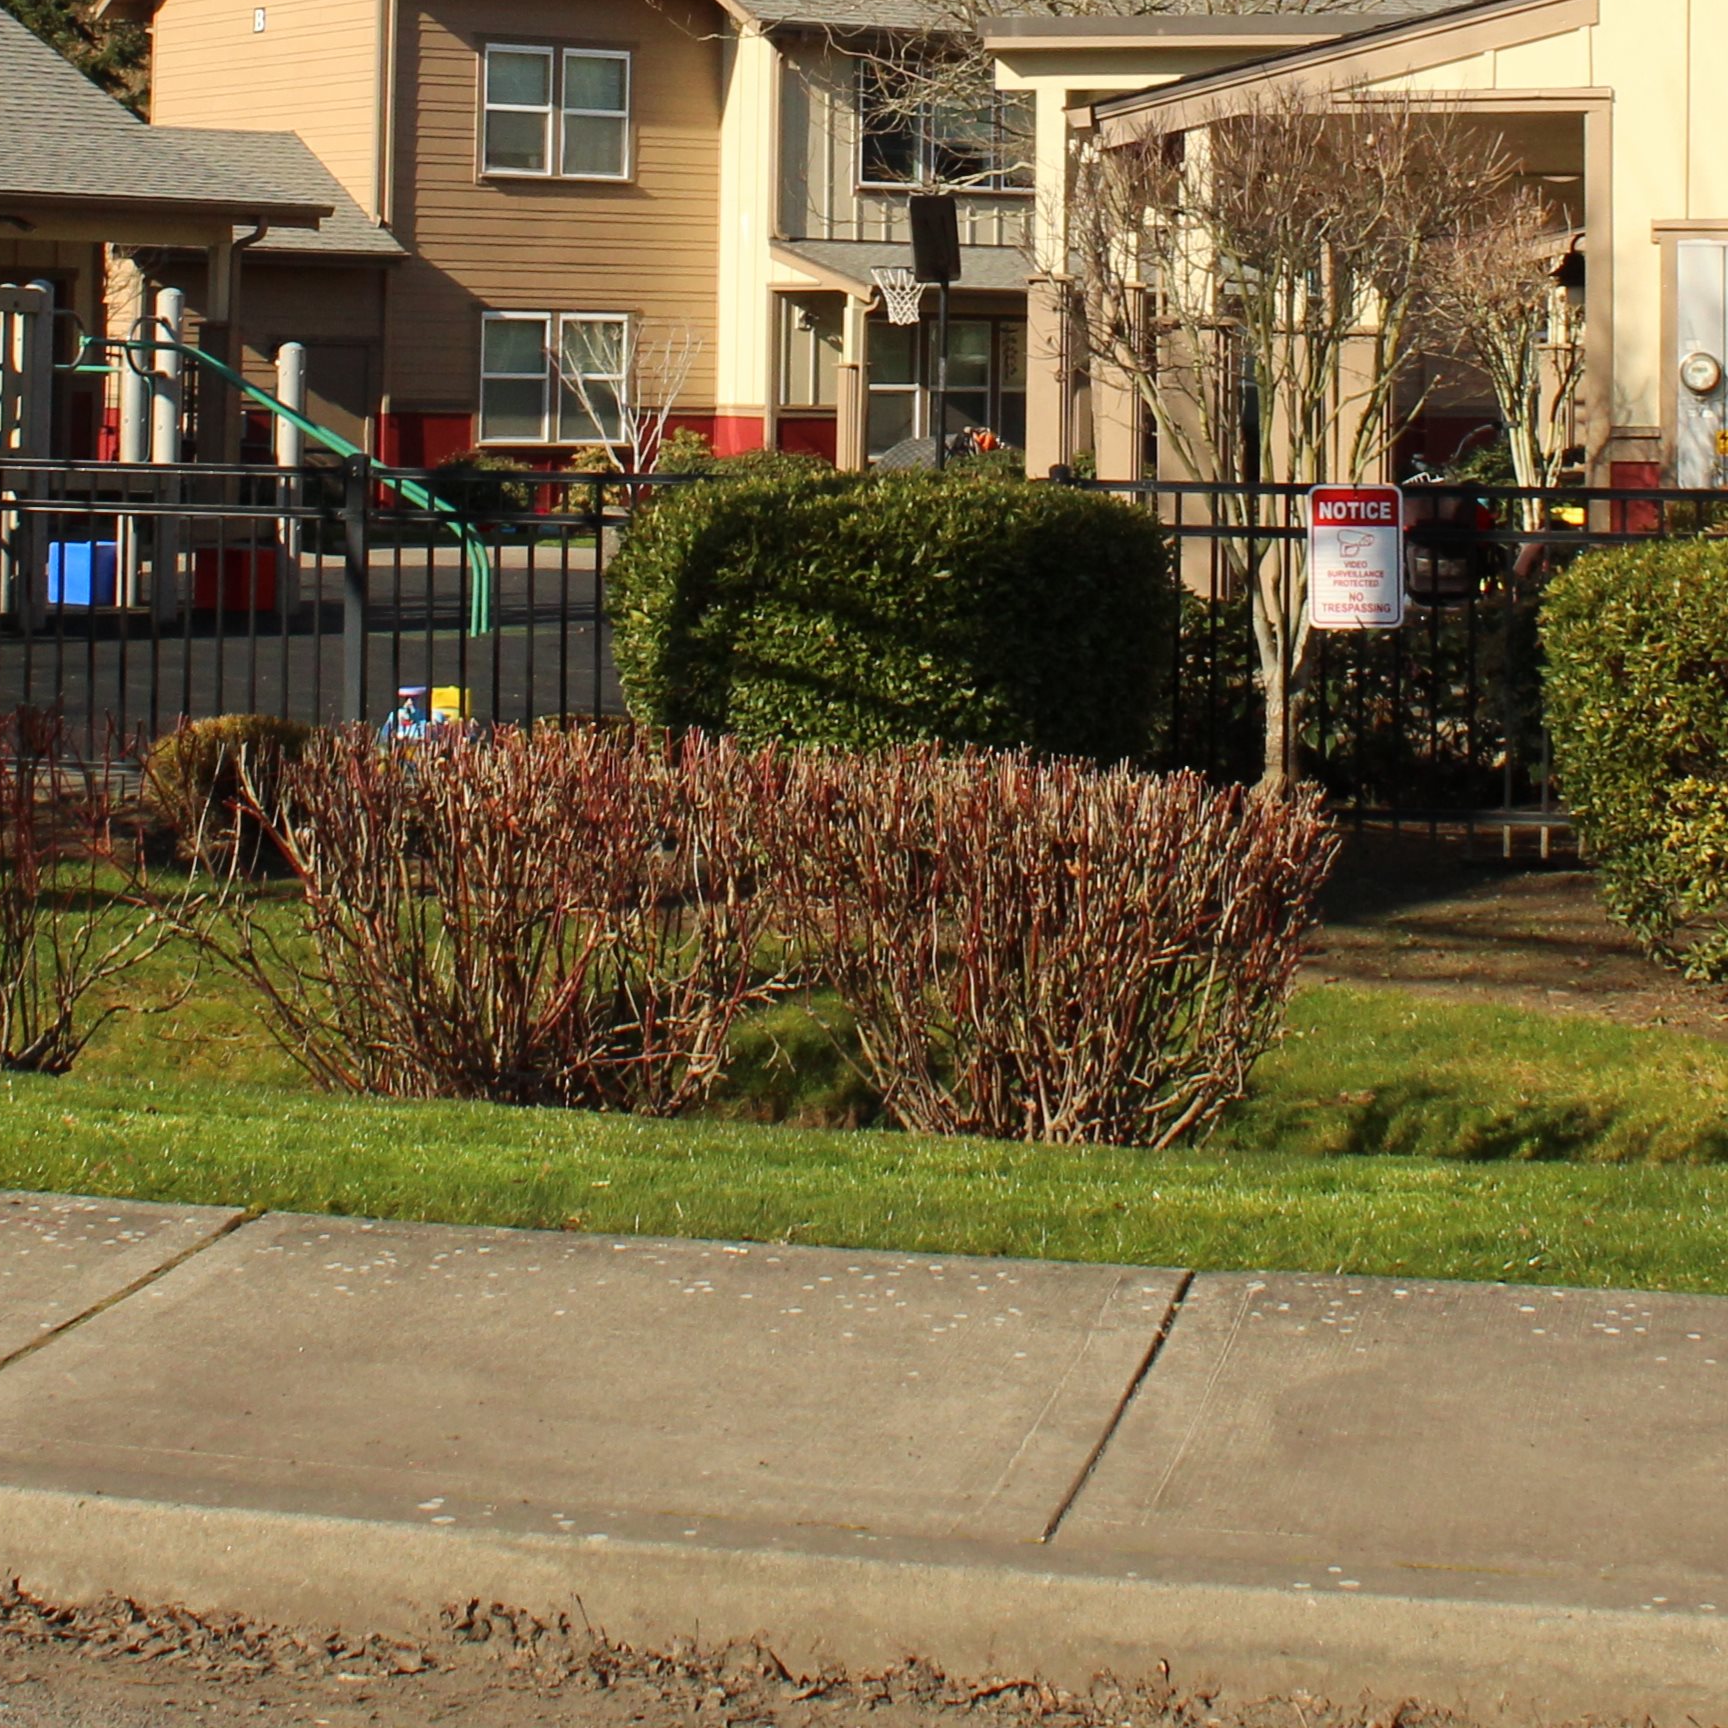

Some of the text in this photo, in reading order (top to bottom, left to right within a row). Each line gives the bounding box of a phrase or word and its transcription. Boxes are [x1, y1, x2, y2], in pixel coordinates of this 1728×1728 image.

[253, 8, 265, 32] B
[1318, 501, 1392, 520] NOTICE
[1344, 560, 1368, 568] VIDEO
[1327, 570, 1384, 578] SURVEILLANCE
[1332, 579, 1379, 587] PROTECTED
[1349, 592, 1364, 602] NO
[1322, 603, 1391, 613] TRESPASSING
